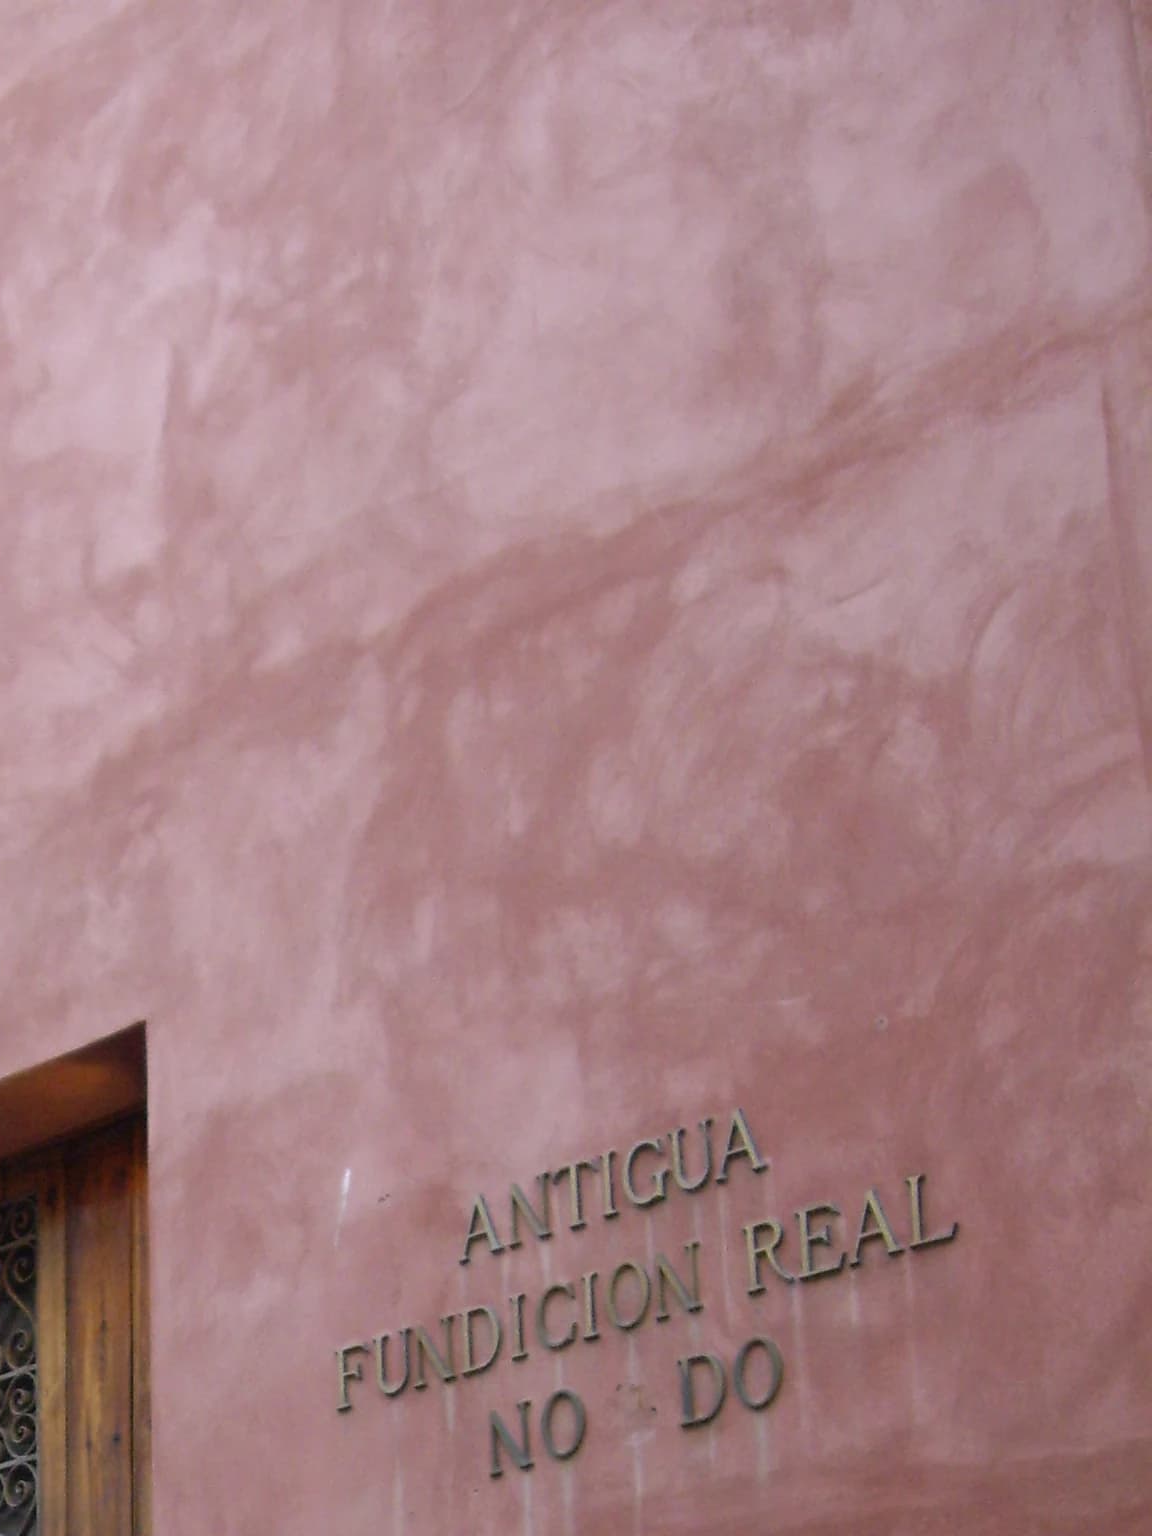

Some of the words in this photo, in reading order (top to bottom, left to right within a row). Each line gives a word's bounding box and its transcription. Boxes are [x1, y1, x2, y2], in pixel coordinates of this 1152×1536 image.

[459, 1108, 768, 1264] ANTIGUA
[335, 1242, 703, 1412] FUNDICION
[742, 1174, 959, 1297] REAL
[489, 1389, 586, 1477] NO
[677, 1336, 784, 1428] DO
